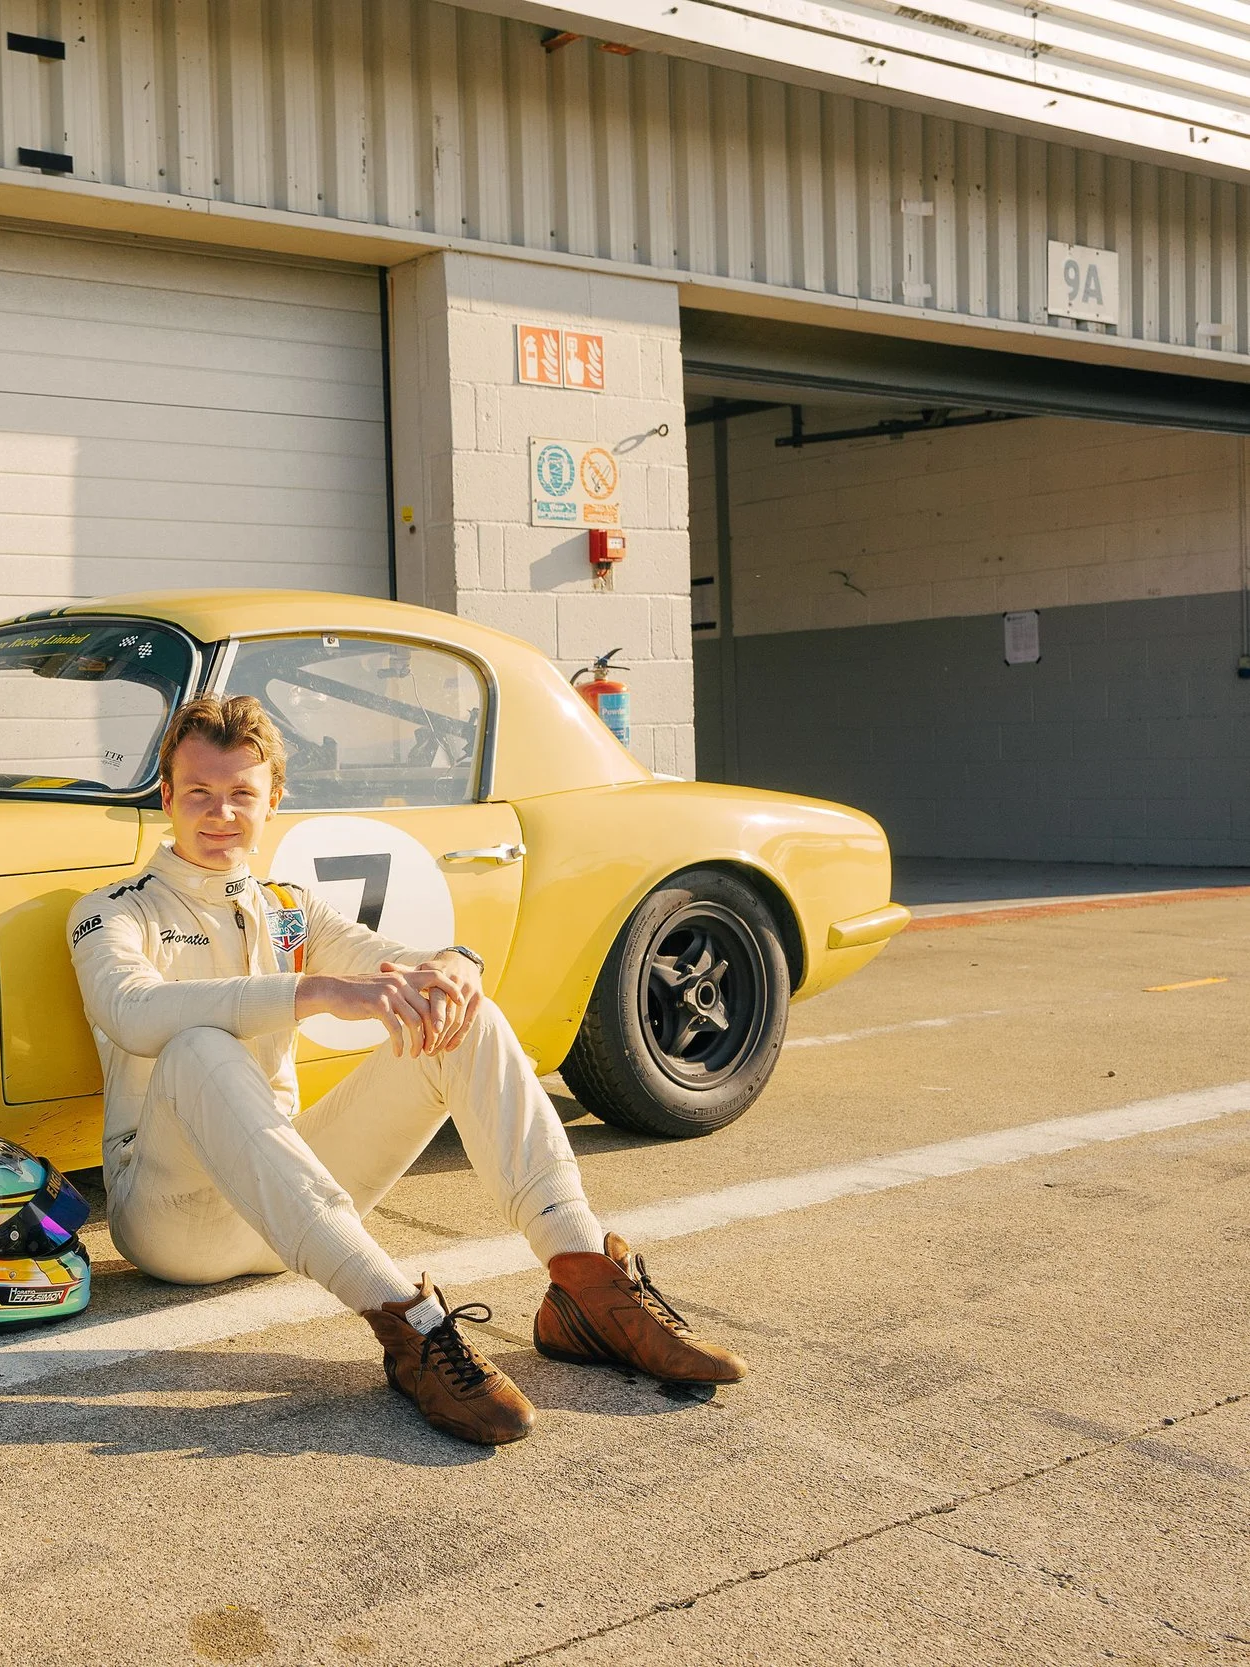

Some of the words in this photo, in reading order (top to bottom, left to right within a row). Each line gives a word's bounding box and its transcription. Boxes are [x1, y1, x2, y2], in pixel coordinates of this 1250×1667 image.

[1063, 259, 1104, 305] 9A
[43, 633, 91, 645] Limited
[104, 749, 124, 762] TTR
[313, 853, 392, 933] 7
[72, 917, 102, 944] OMP
[159, 929, 210, 946] Horatio
